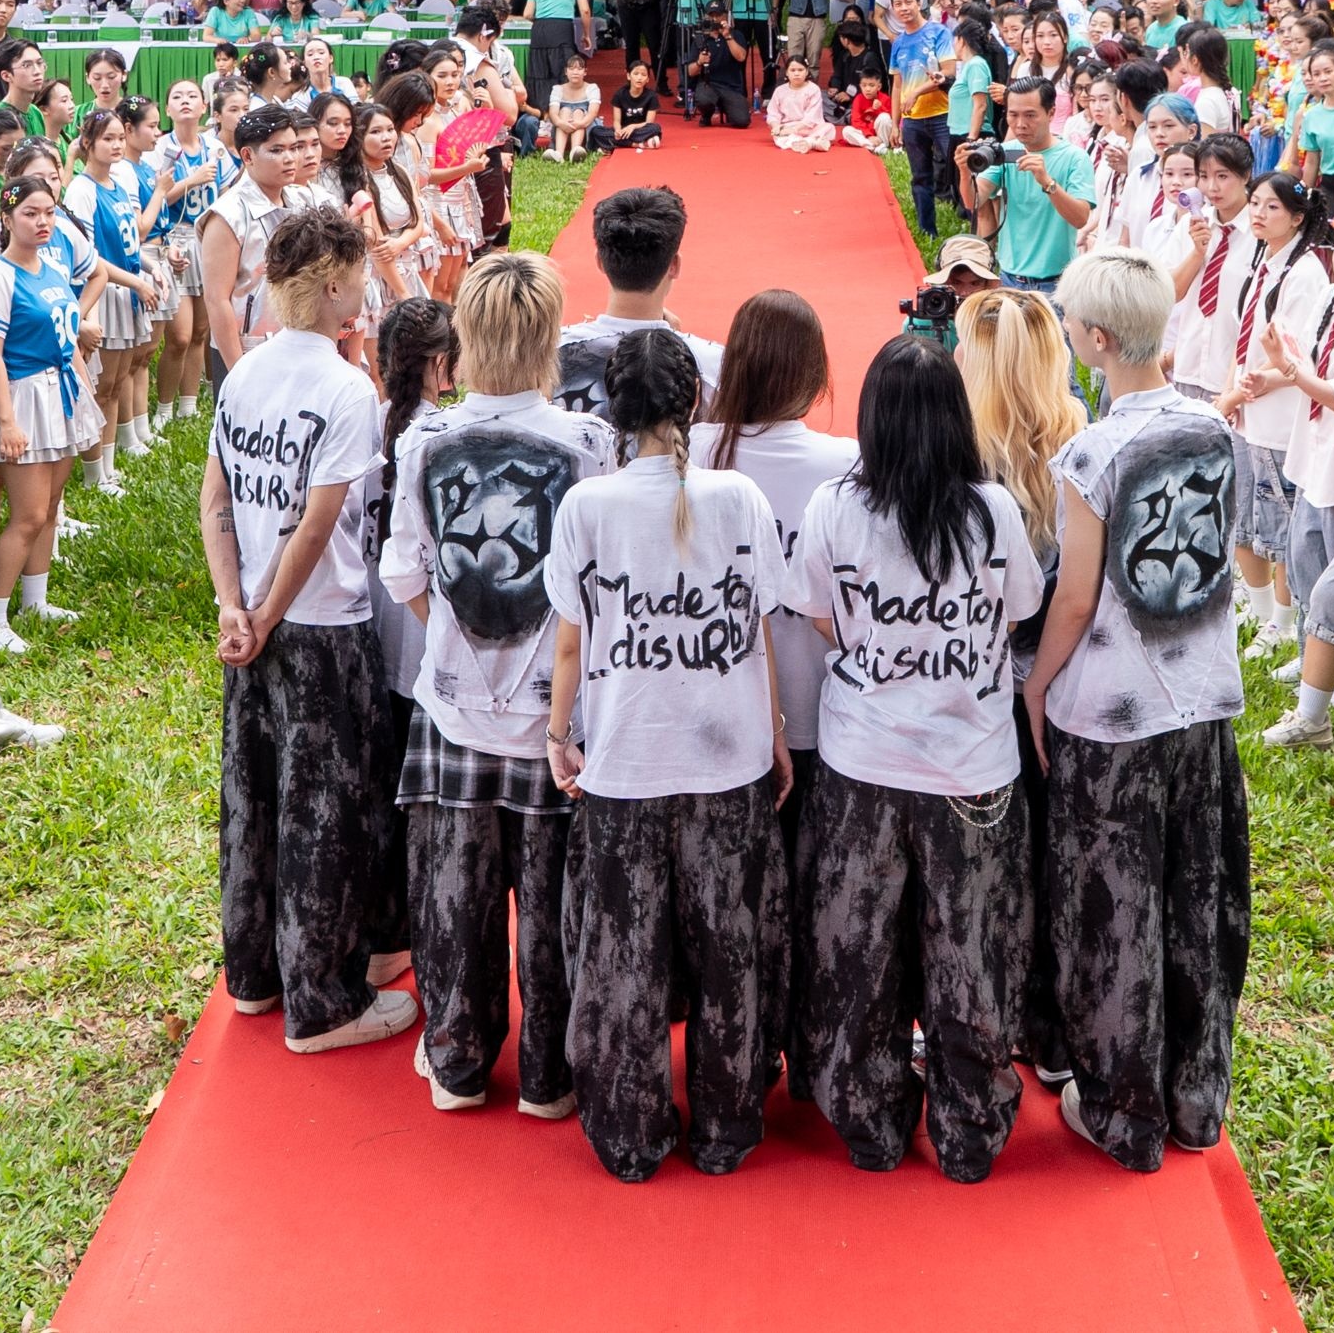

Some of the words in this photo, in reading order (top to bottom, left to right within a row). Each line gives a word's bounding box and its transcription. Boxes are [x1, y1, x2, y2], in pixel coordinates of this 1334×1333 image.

[186, 181, 219, 216] 30
[51, 301, 81, 350] 30
[594, 570, 720, 621] Made
[711, 565, 752, 612] to
[840, 579, 966, 632] Made
[959, 575, 994, 628] to
